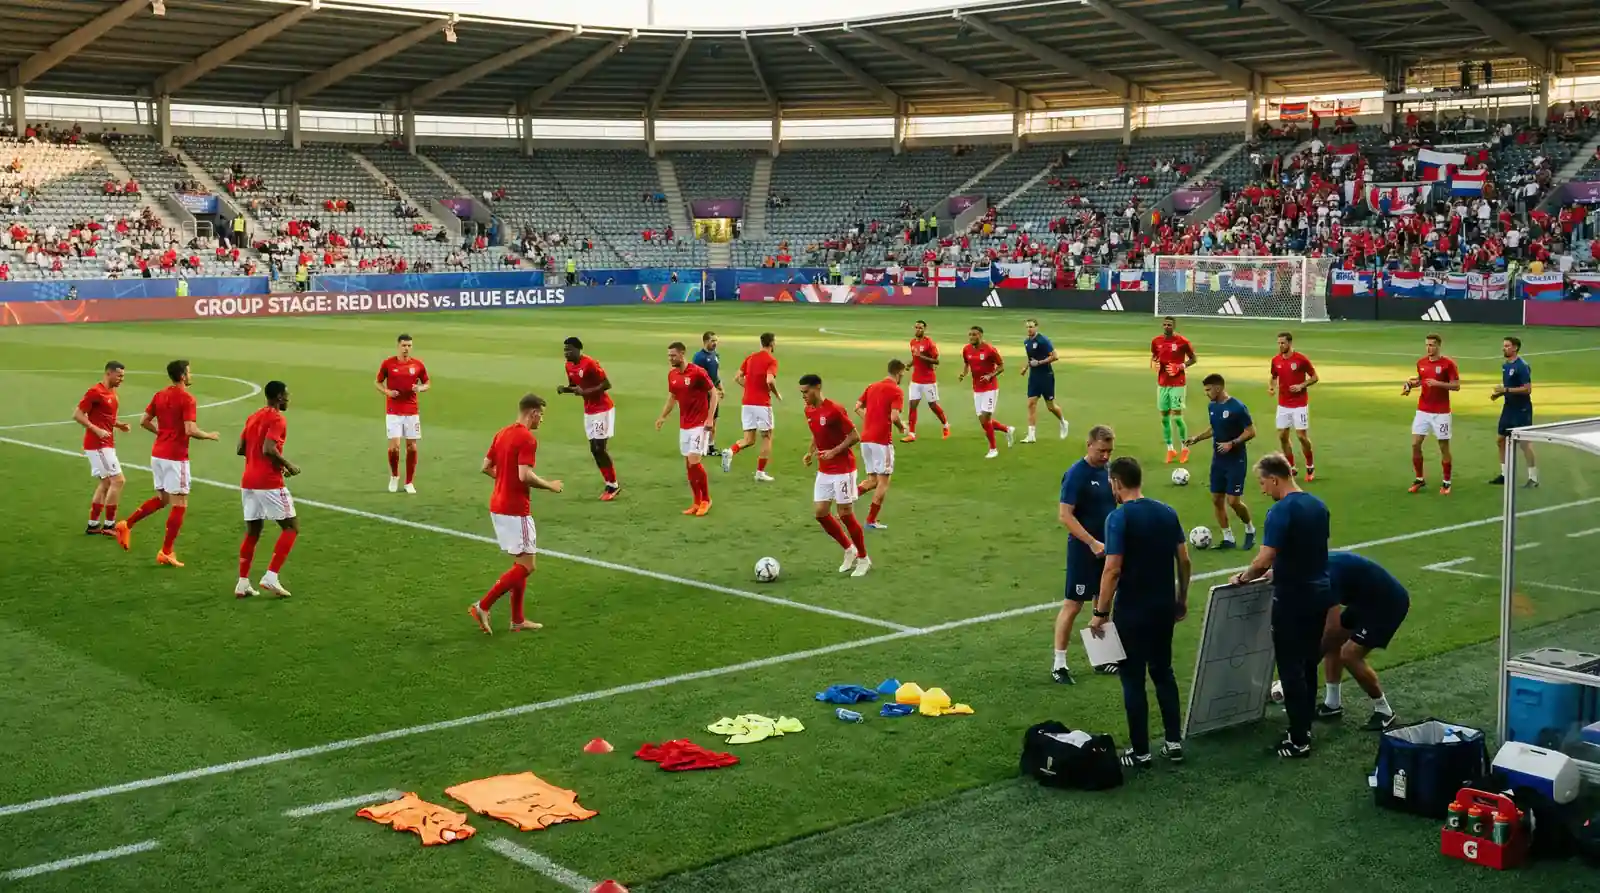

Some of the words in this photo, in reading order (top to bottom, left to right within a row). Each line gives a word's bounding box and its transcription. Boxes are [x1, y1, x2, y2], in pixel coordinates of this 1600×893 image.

[194, 298, 264, 316] GROUP
[268, 296, 332, 314] STAGE:
[336, 294, 373, 311] RED
[377, 292, 429, 310] LIONS
[433, 296, 456, 308] vs.
[459, 290, 501, 307] BLUE
[505, 289, 565, 305] EAGLES
[841, 481, 848, 495] 4
[1449, 816, 1460, 828] G
[1462, 840, 1478, 859] G
